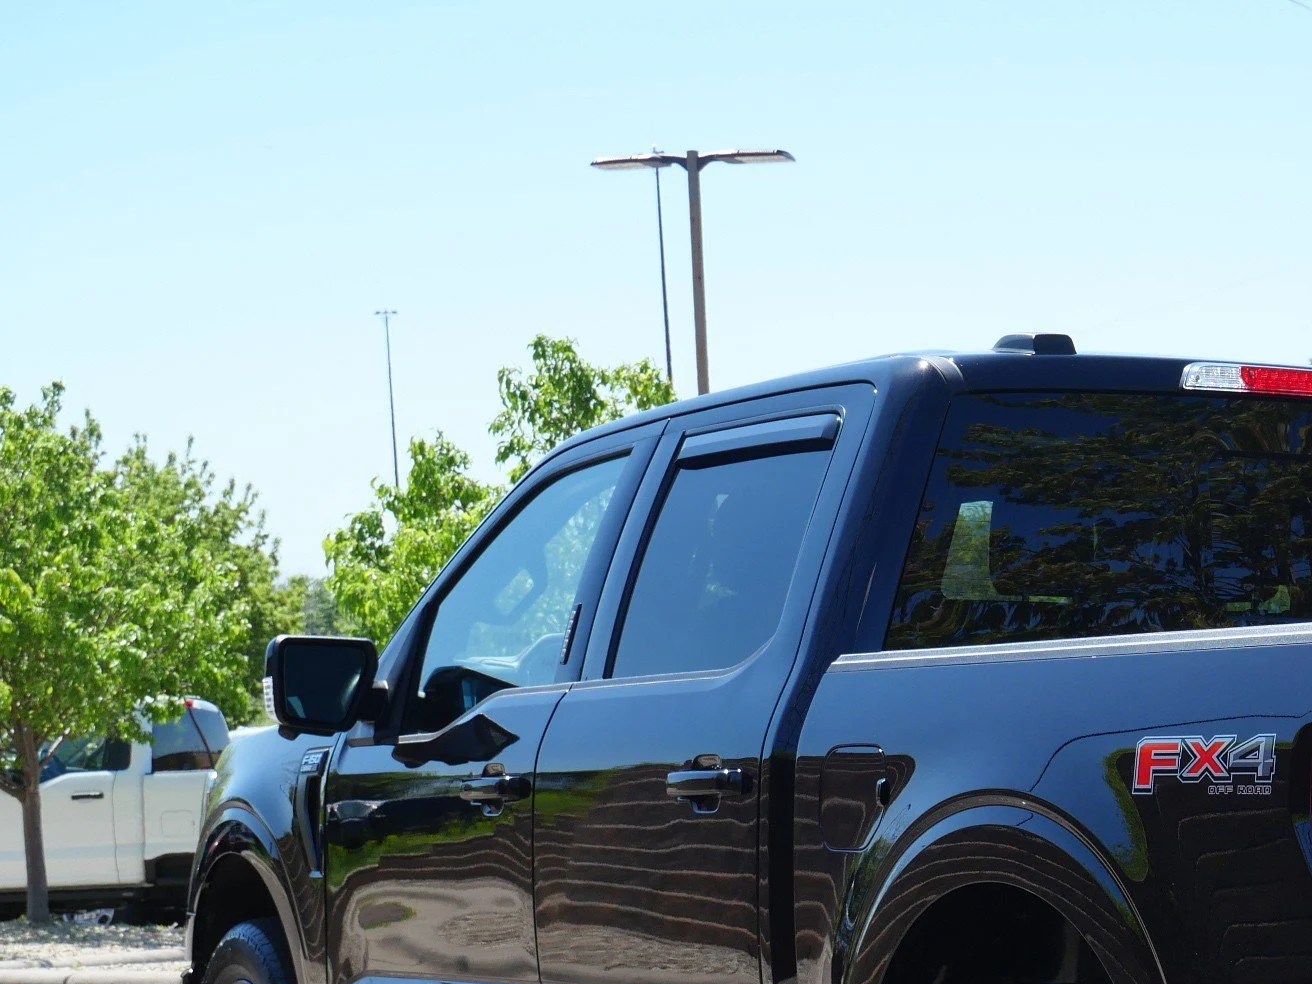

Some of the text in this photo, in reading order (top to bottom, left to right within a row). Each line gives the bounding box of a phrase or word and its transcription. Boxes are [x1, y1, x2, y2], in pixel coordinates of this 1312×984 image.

[1132, 733, 1277, 795] FX4
[1208, 785, 1272, 795] OFF ROAD
